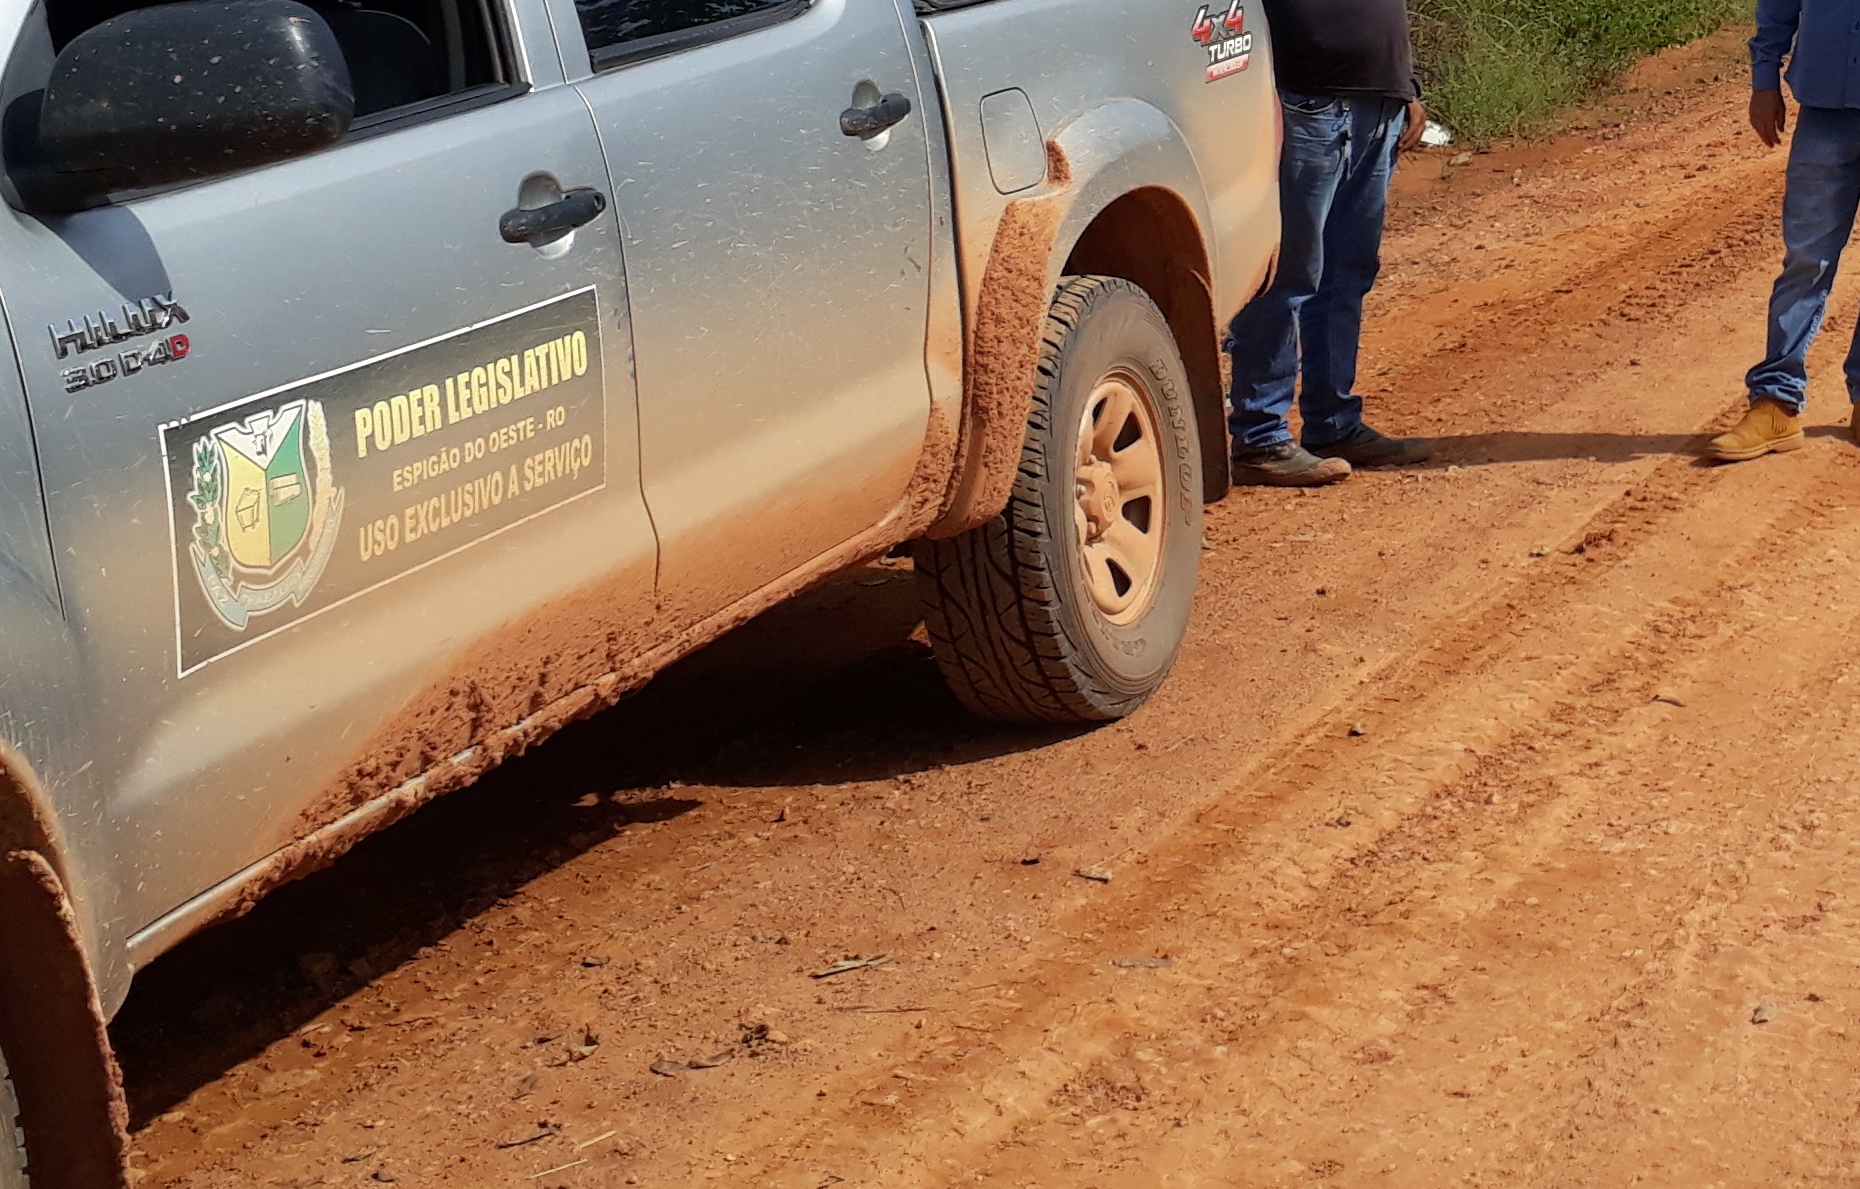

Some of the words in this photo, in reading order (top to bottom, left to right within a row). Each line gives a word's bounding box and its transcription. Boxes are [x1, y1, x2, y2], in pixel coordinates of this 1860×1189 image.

[1209, 33, 1252, 62] TURBO
[48, 291, 190, 359] HILUX
[355, 384, 442, 459] PODER
[445, 330, 588, 424] LEGISLATIVO
[1149, 358, 1193, 527] DUNLOP
[359, 514, 400, 562] USO
[404, 470, 503, 544] EXCLUSIVO
[507, 464, 520, 500] A
[523, 433, 593, 492] SERVIÇO
[392, 447, 460, 493] ESPIGÃO
[464, 437, 485, 464] DO
[489, 416, 535, 453] OESTE
[546, 405, 566, 431] RO
